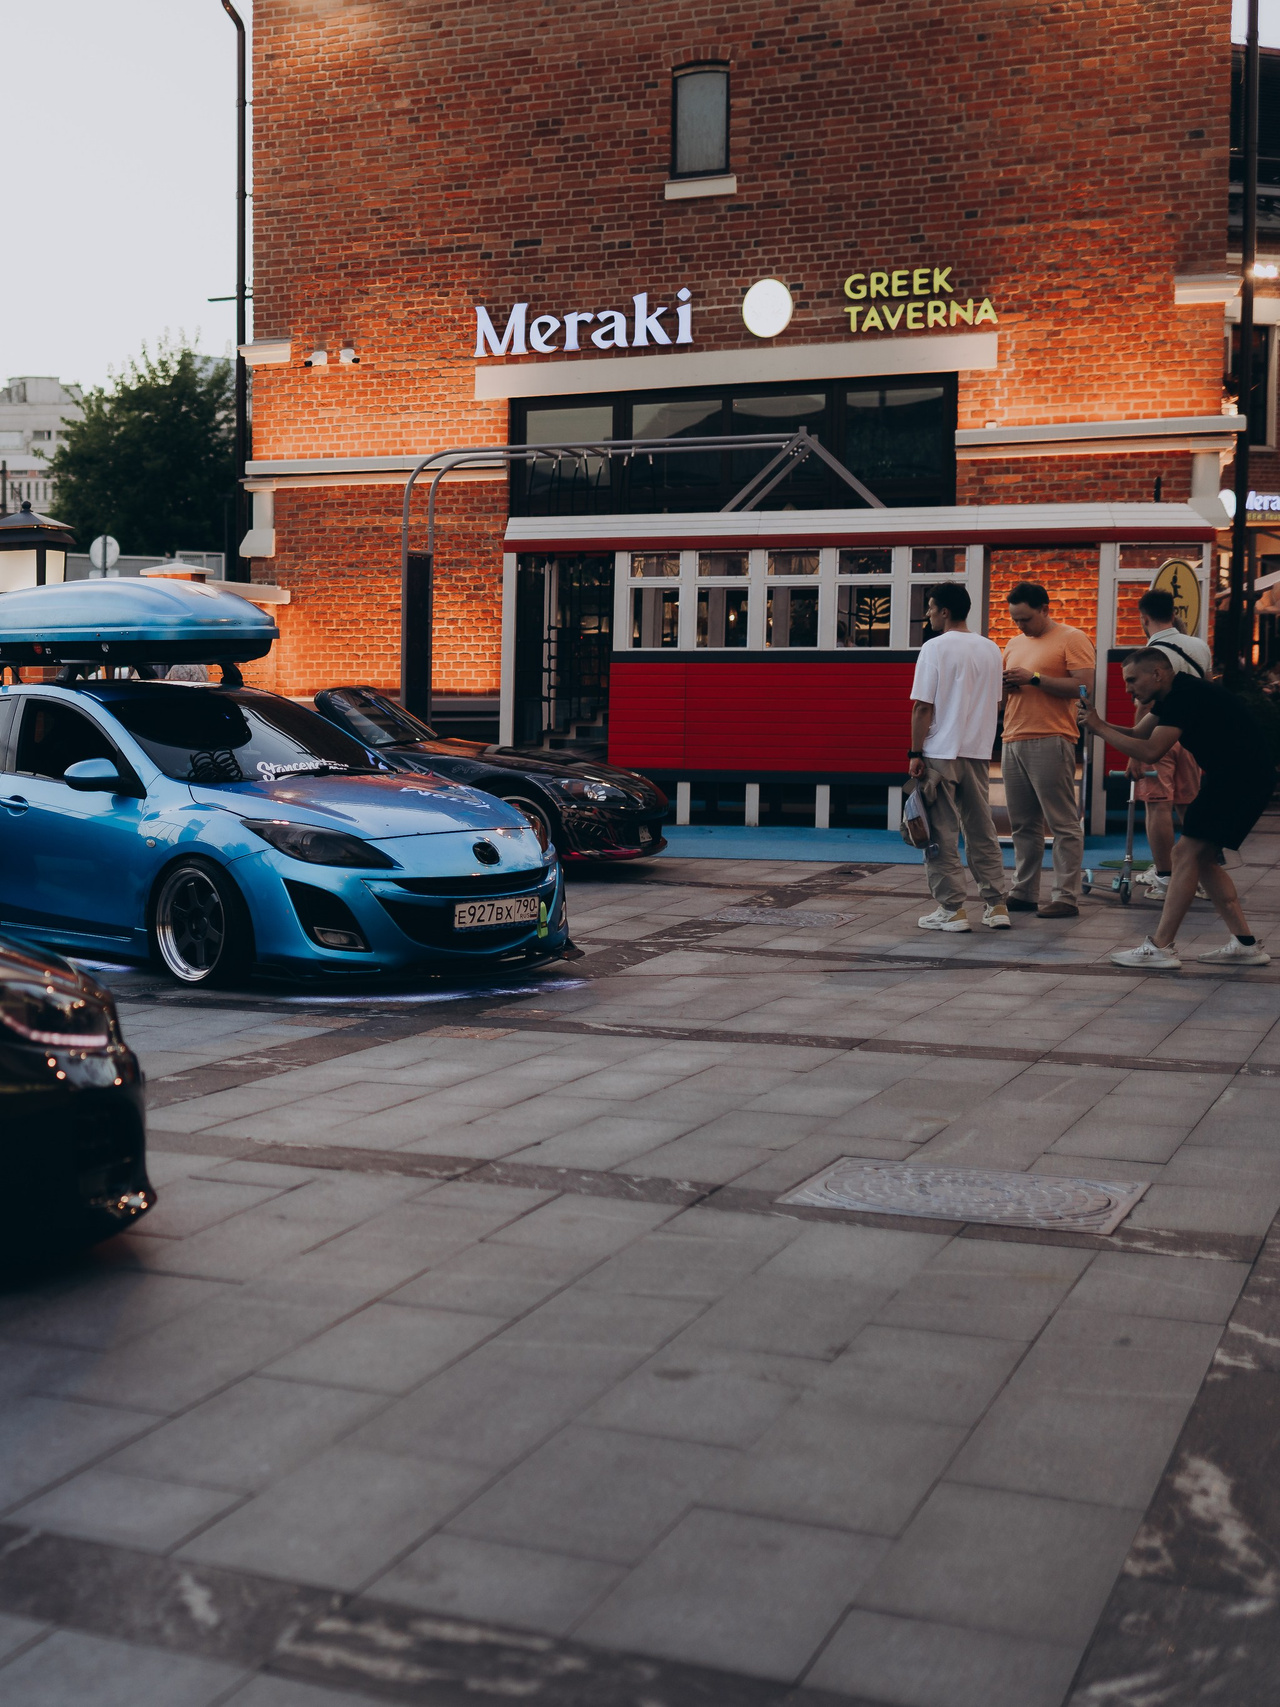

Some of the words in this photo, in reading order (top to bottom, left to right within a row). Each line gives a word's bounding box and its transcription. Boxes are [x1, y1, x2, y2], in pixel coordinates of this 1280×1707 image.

[844, 266, 954, 300] GREEK
[473, 287, 694, 357] Meraki
[844, 297, 999, 333] TAVERNA
[458, 903, 513, 924] E927BX
[516, 898, 535, 913] 790
